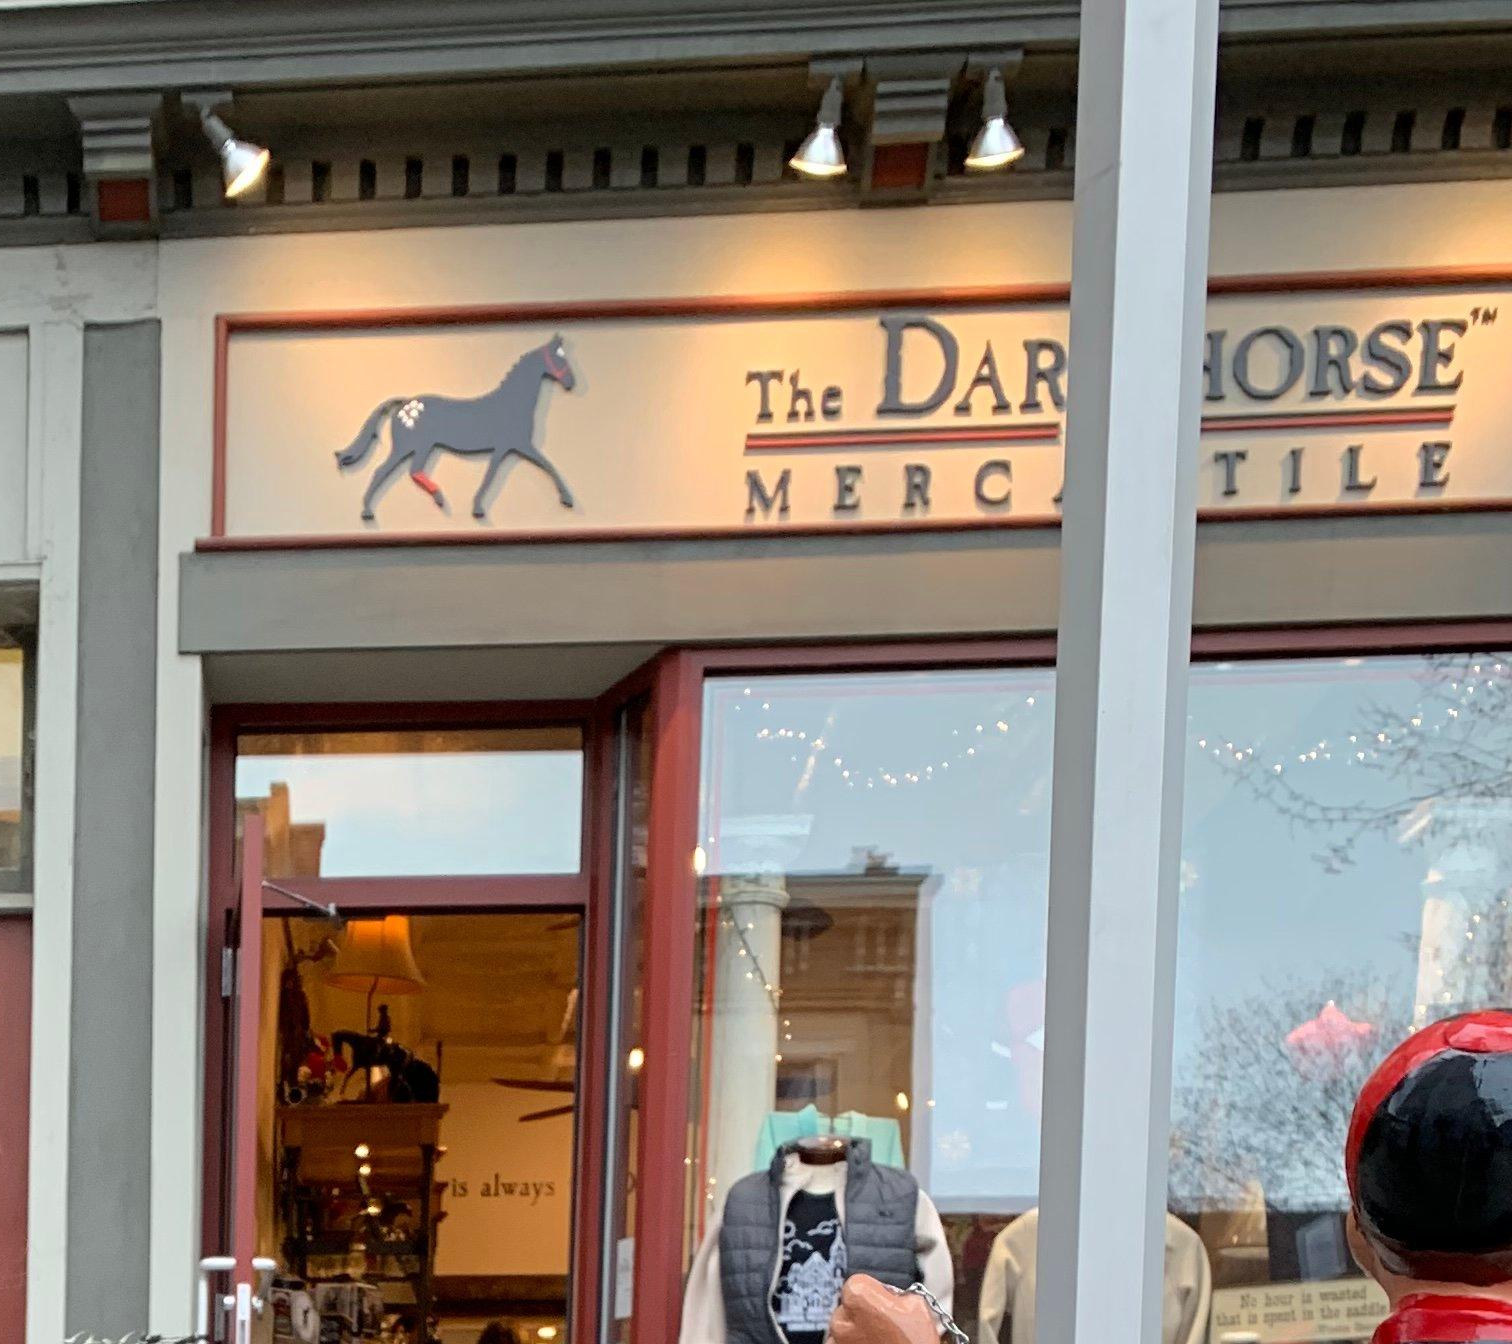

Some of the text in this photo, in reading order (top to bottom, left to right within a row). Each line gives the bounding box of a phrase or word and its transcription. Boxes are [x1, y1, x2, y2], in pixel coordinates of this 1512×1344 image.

[746, 368, 845, 424] The
[876, 315, 1068, 418] DAR
[451, 1172, 556, 1207] is always
[1264, 1291, 1294, 1308] hour
[1319, 1285, 1368, 1302] wasted
[1215, 1311, 1241, 1327] that
